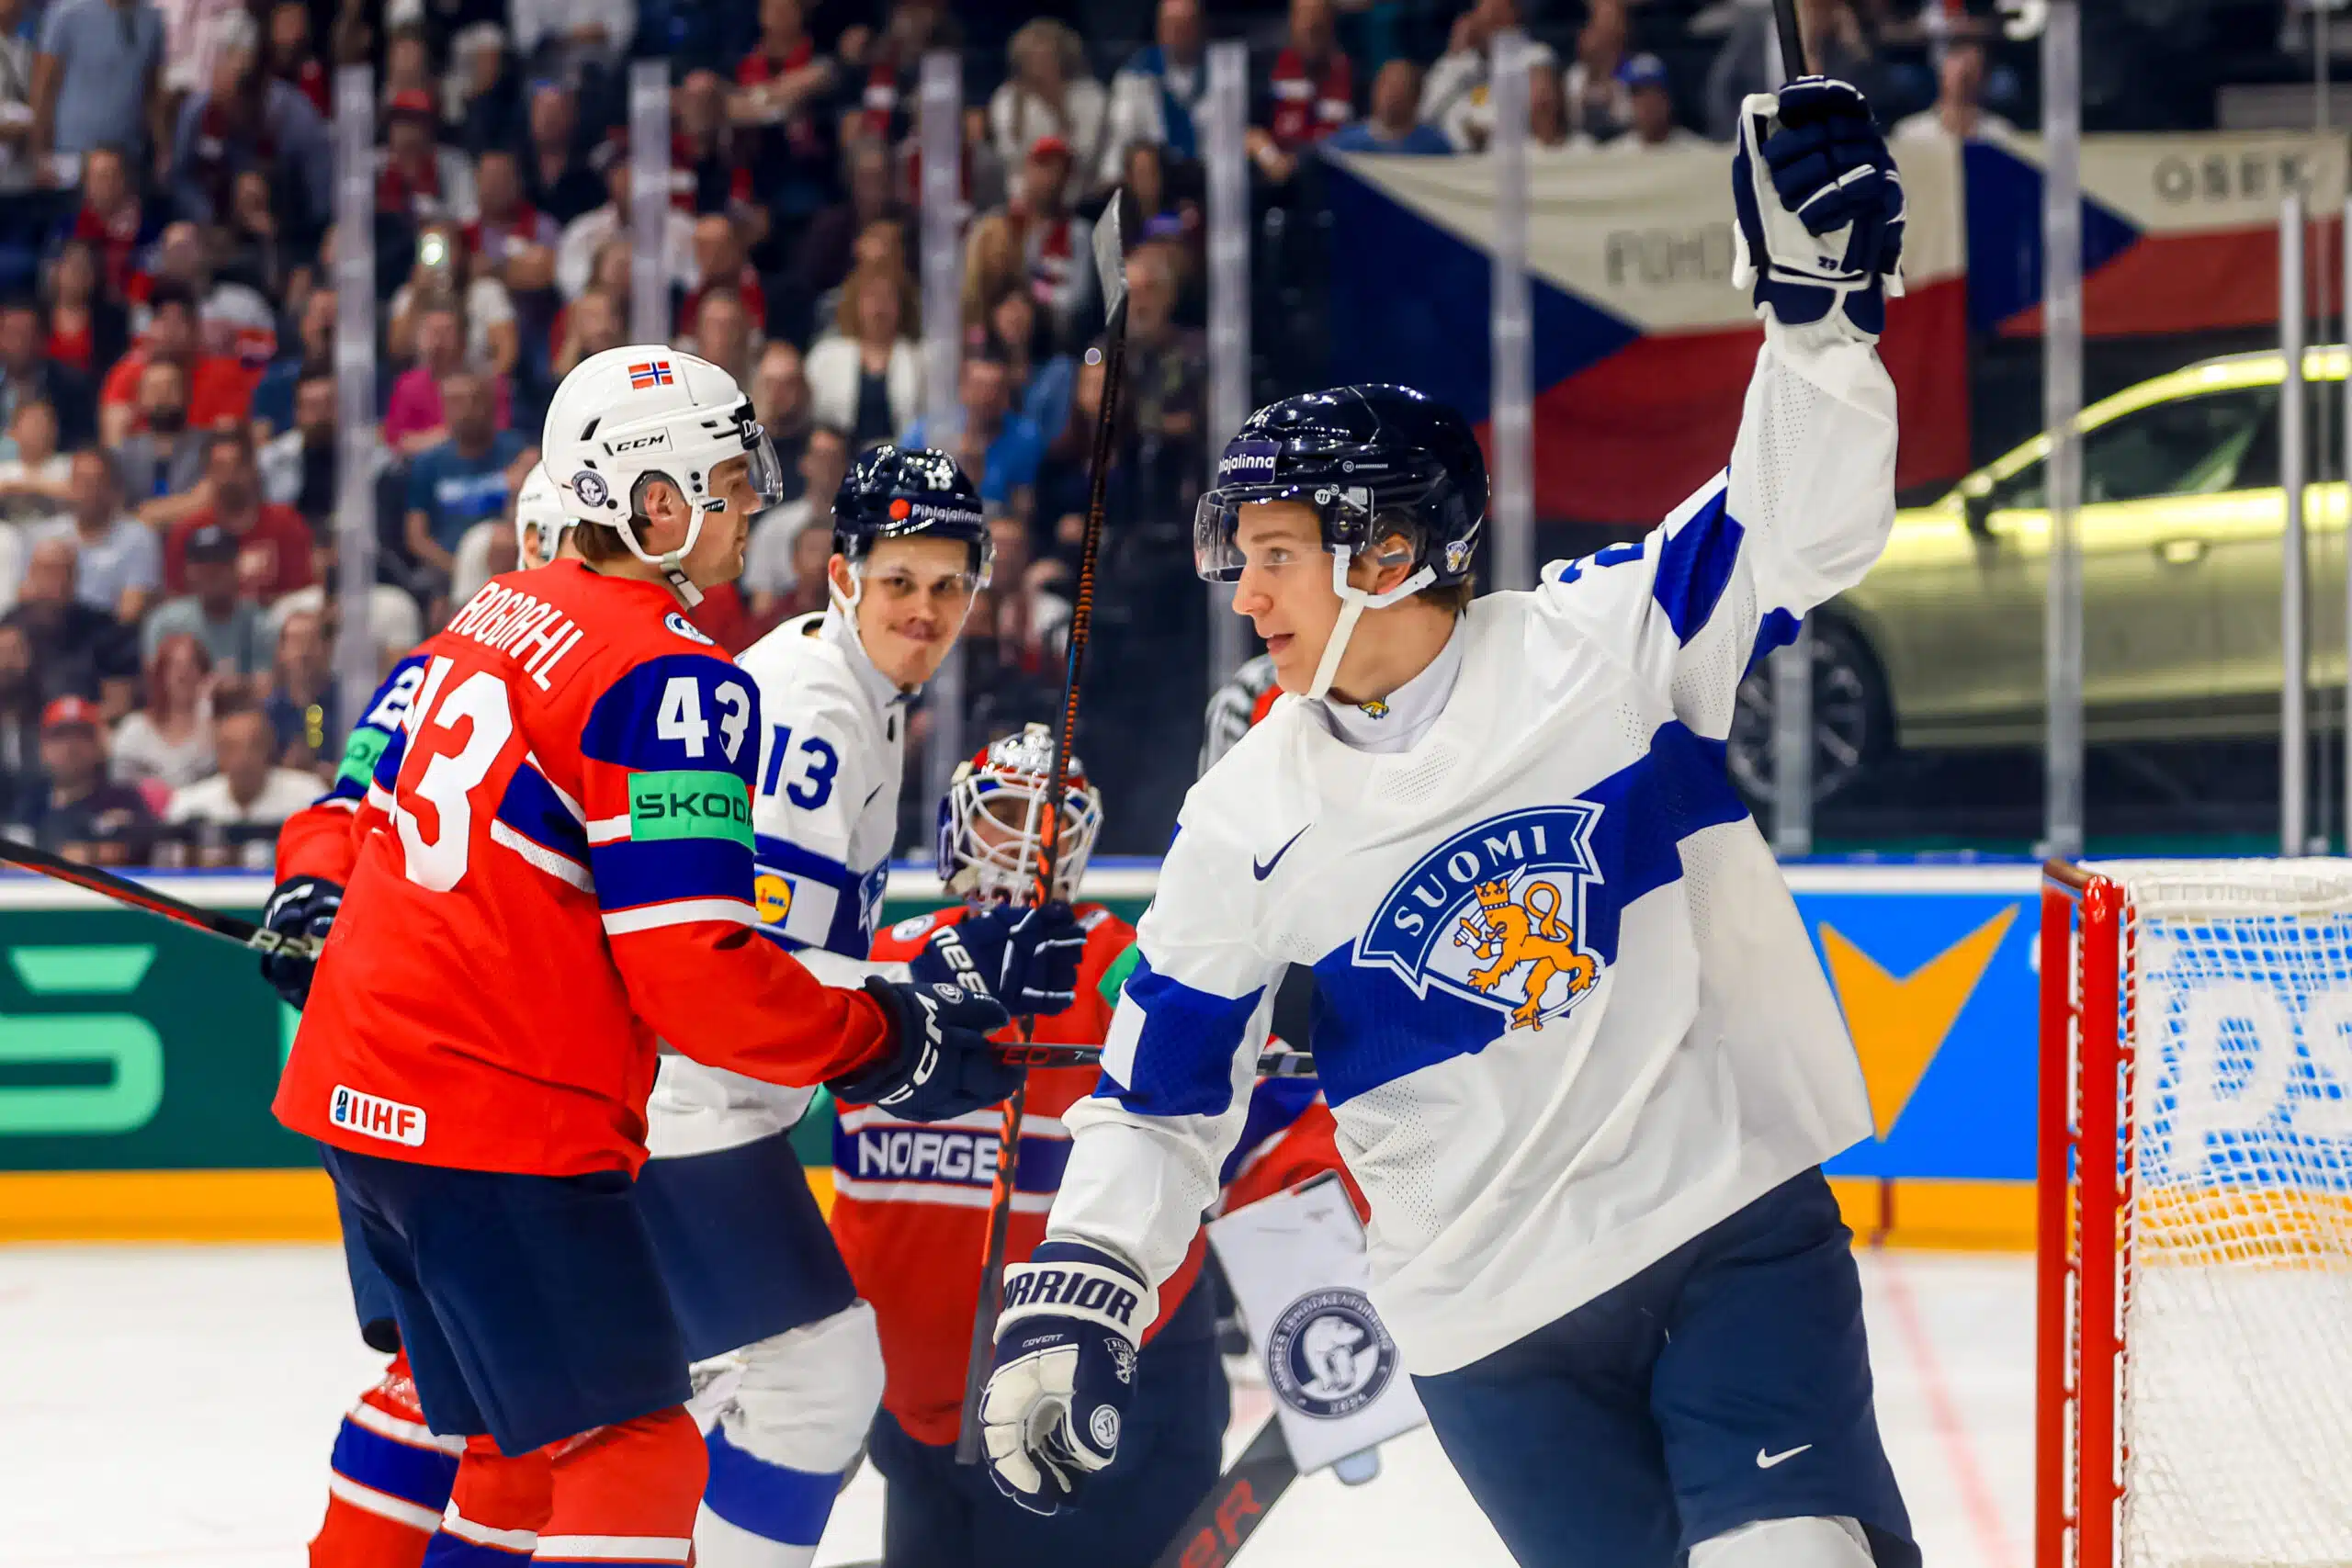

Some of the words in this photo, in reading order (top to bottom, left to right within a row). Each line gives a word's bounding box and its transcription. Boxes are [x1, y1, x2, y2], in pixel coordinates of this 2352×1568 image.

[616, 434, 665, 453] CCM
[911, 502, 982, 524] Pihlajalinna
[368, 665, 425, 732] 2
[656, 676, 751, 764] 43
[761, 723, 840, 811] 13
[1394, 825, 1547, 938] SUOMI
[350, 1094, 416, 1138] IIHF
[858, 1131, 1002, 1181] NORGE
[1022, 1333, 1065, 1348] COVERT
